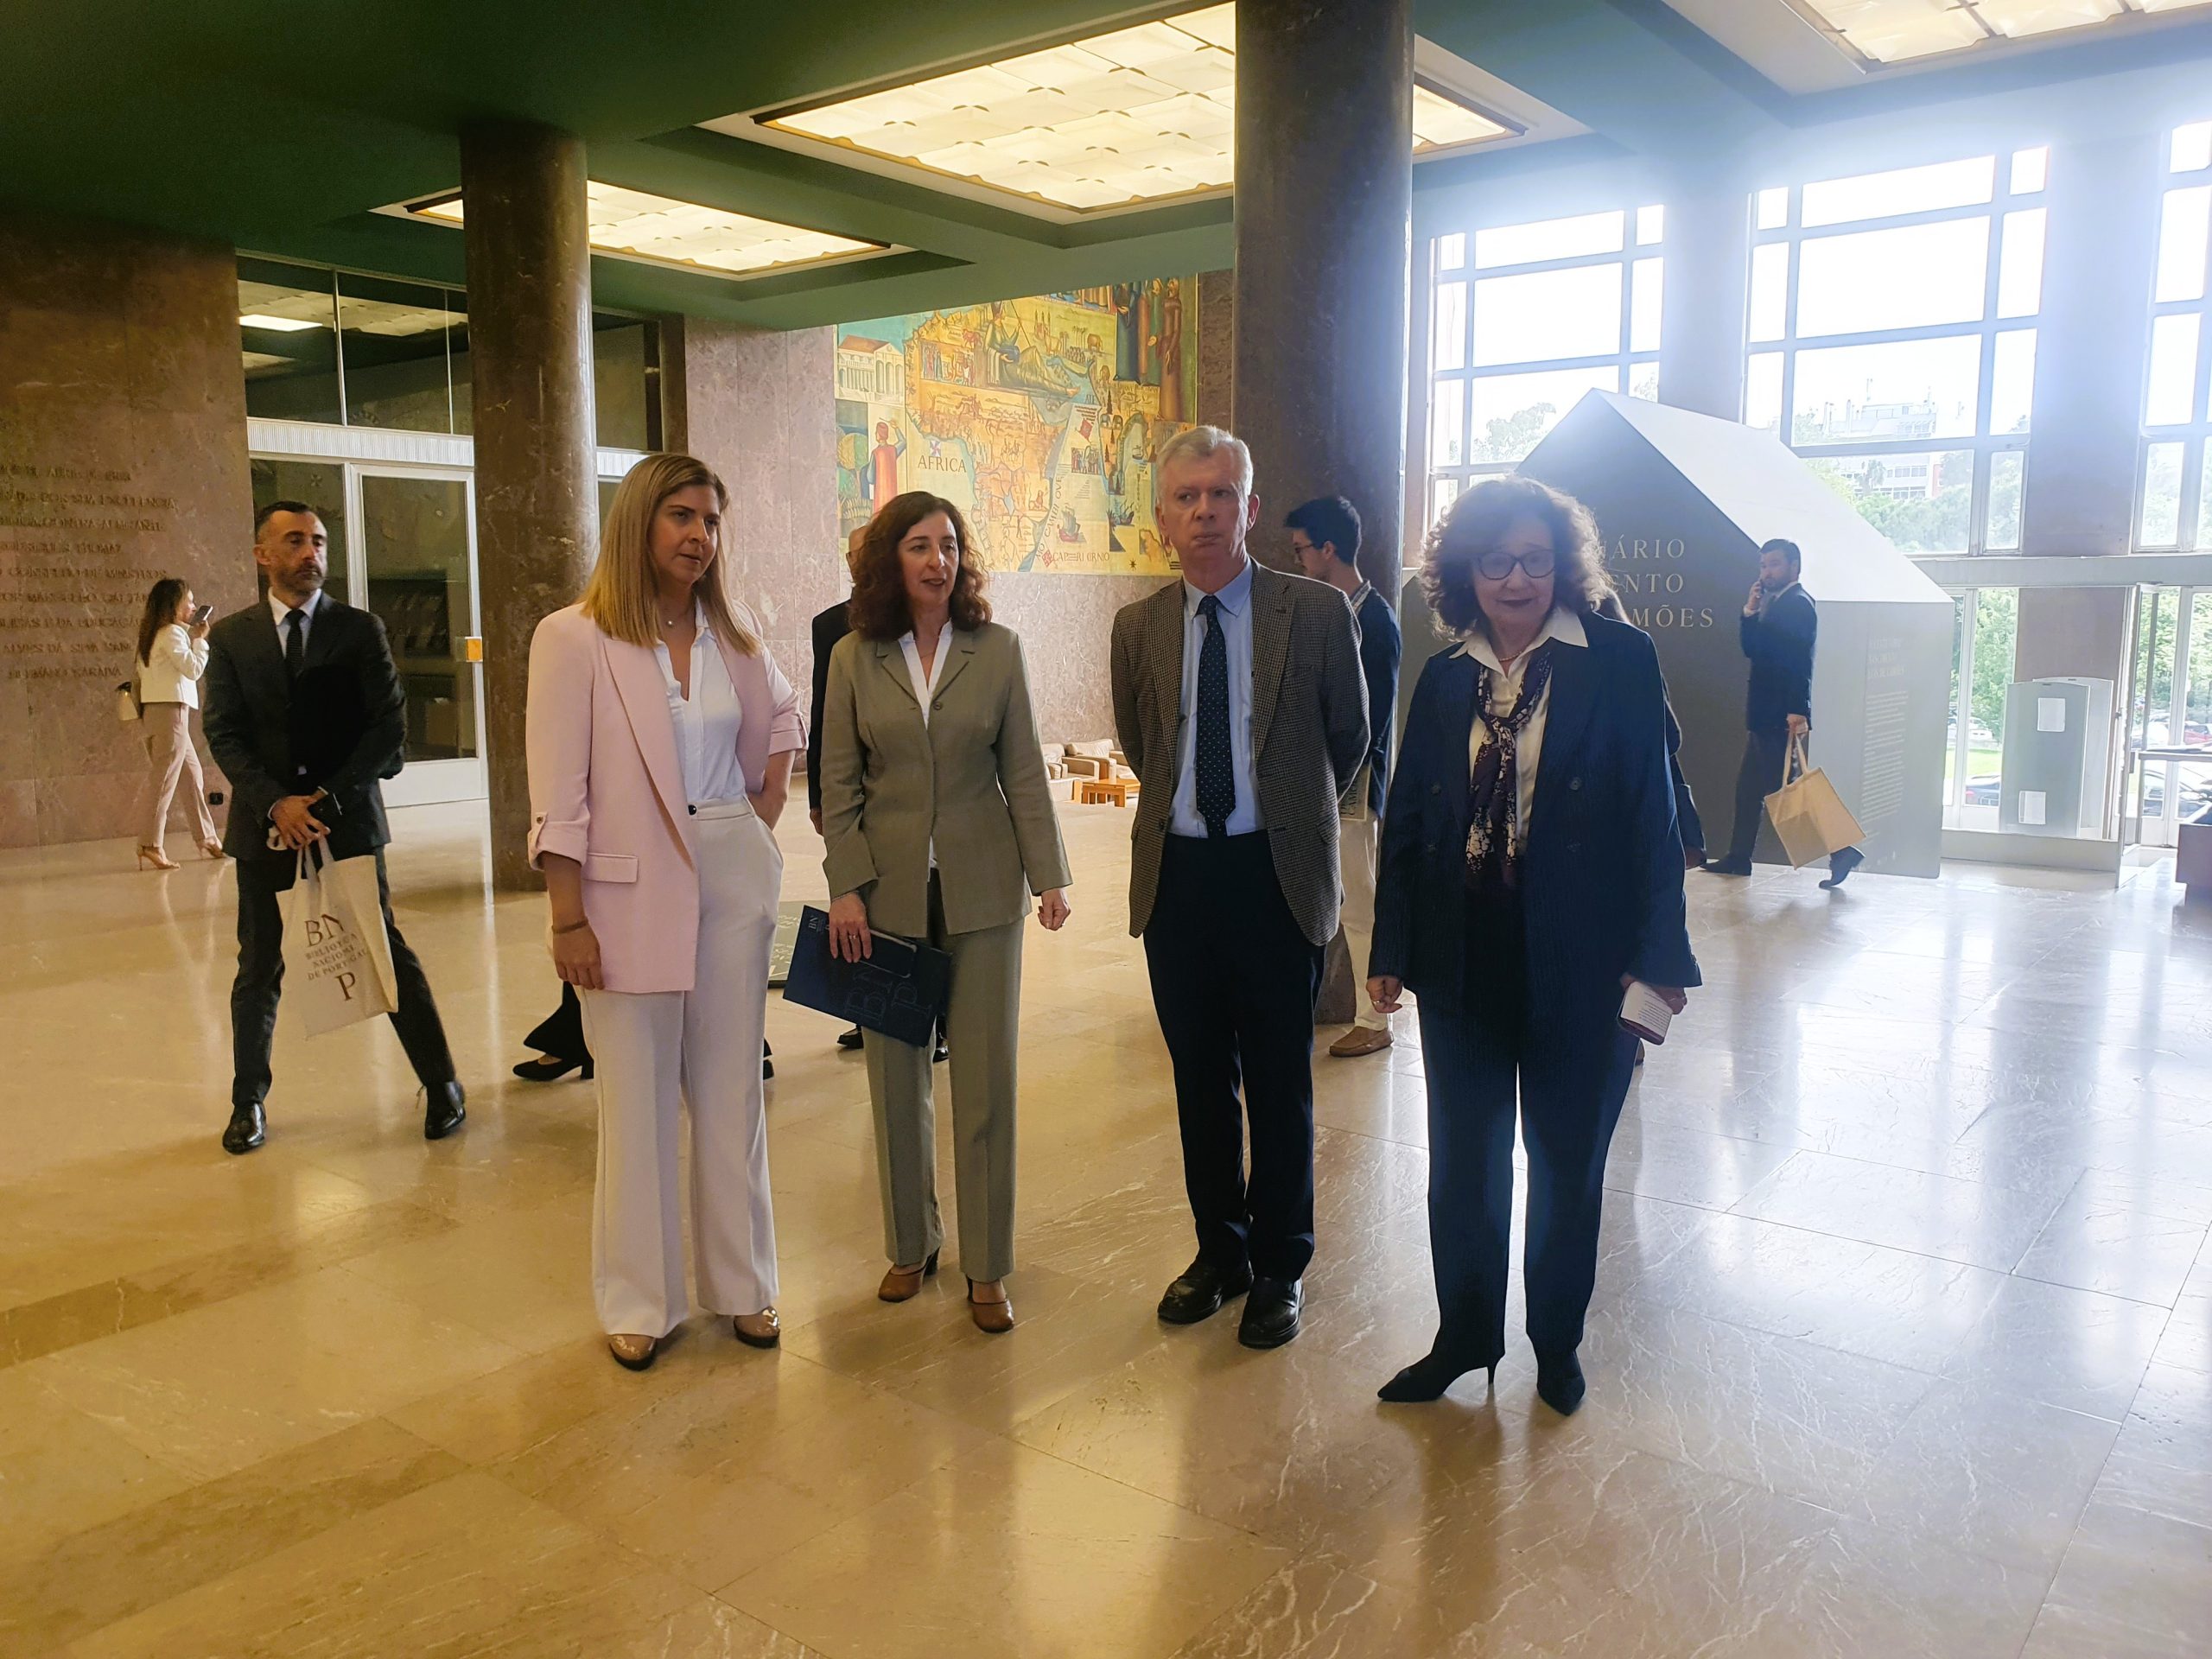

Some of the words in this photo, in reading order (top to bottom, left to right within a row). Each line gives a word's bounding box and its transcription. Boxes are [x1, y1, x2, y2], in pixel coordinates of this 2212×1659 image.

[918, 454, 967, 473] AFRICA
[1630, 604, 1713, 627] MÕES
[334, 971, 356, 1002] P
